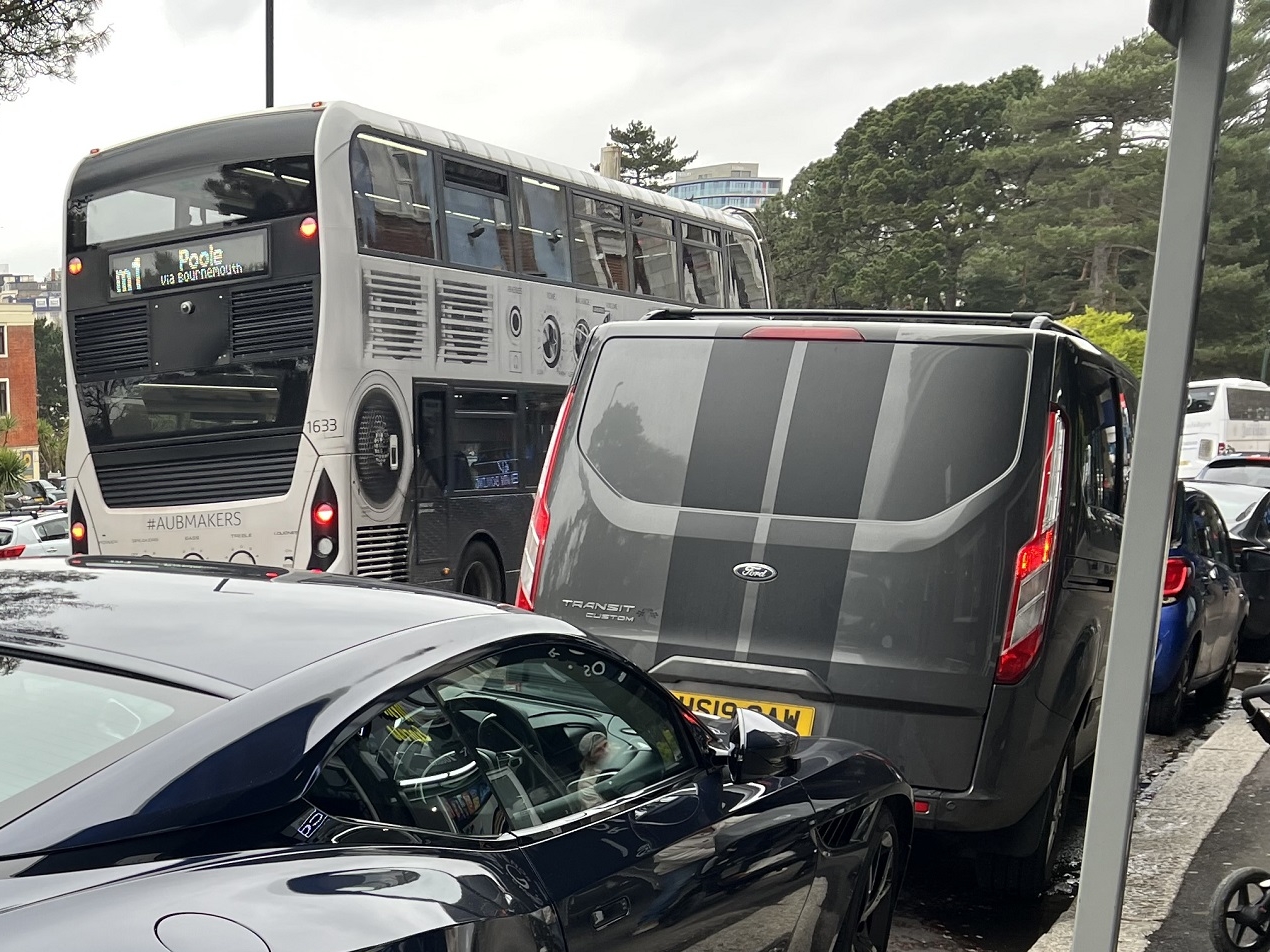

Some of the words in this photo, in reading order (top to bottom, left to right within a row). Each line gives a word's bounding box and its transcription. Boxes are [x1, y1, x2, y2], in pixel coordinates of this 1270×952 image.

[178, 244, 224, 271] Poole
[115, 256, 142, 293] m1
[160, 273, 175, 286] via
[177, 262, 243, 283] Bournemouth
[307, 418, 338, 433] 1633
[146, 511, 242, 530] #AUBMAKERS
[562, 599, 636, 613] TRANSIT
[585, 612, 635, 622] CUSTOM
